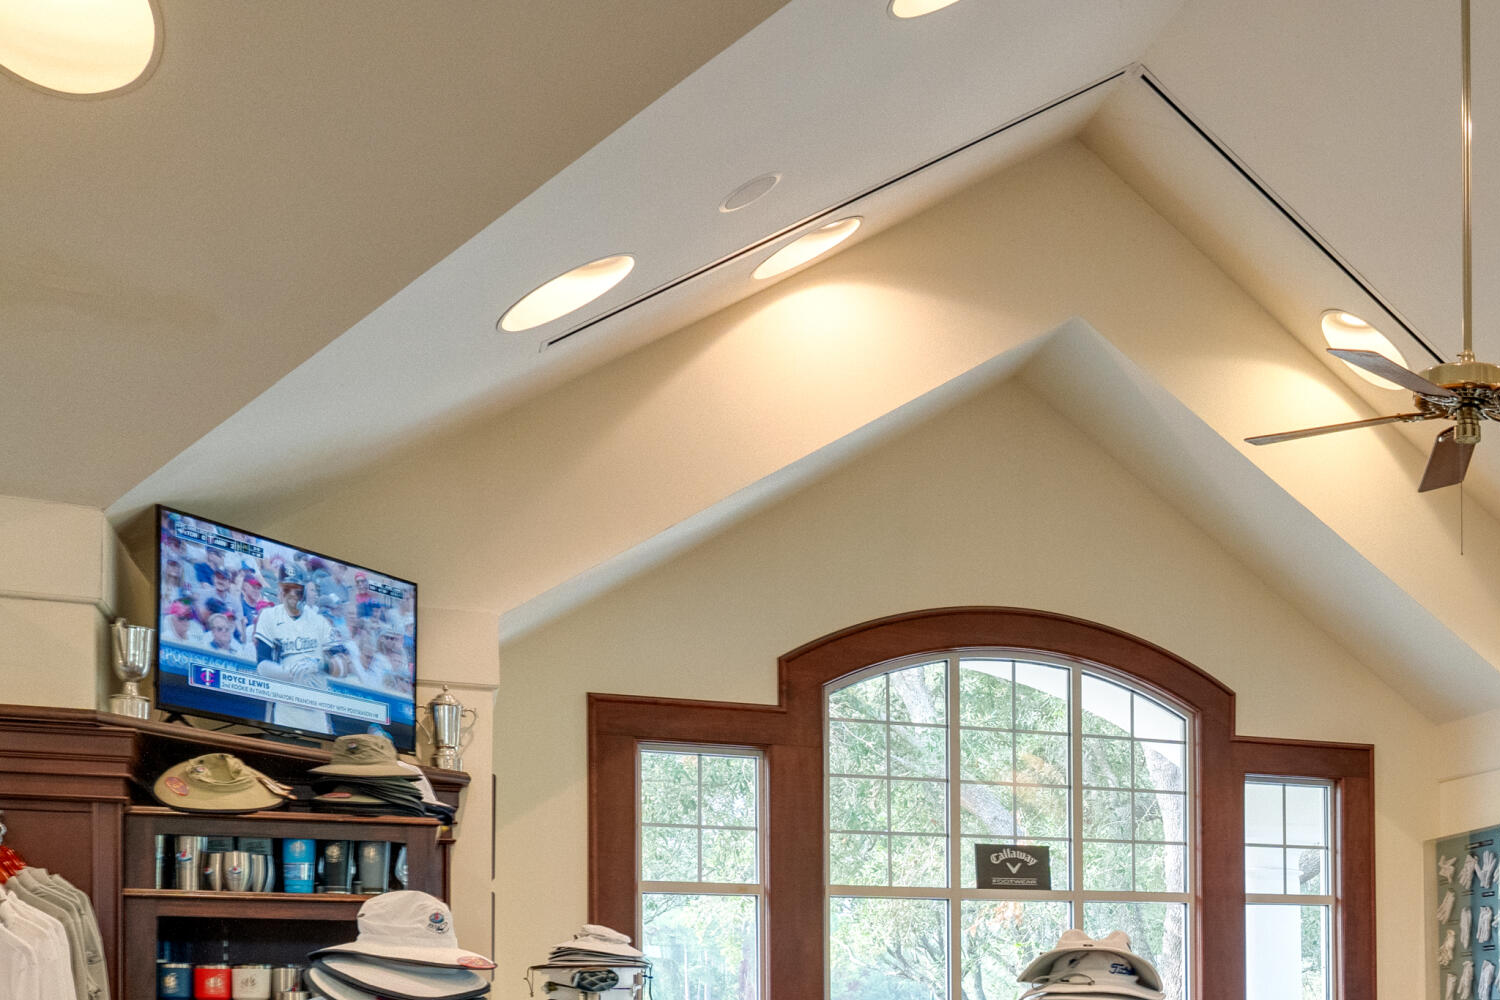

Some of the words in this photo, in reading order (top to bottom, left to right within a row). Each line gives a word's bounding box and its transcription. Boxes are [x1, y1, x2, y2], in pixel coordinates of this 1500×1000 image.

[222, 673, 245, 685] ROYCE
[248, 679, 270, 690] LEWIS
[231, 683, 248, 692] ROOKIE
[990, 848, 1038, 866] Callaway
